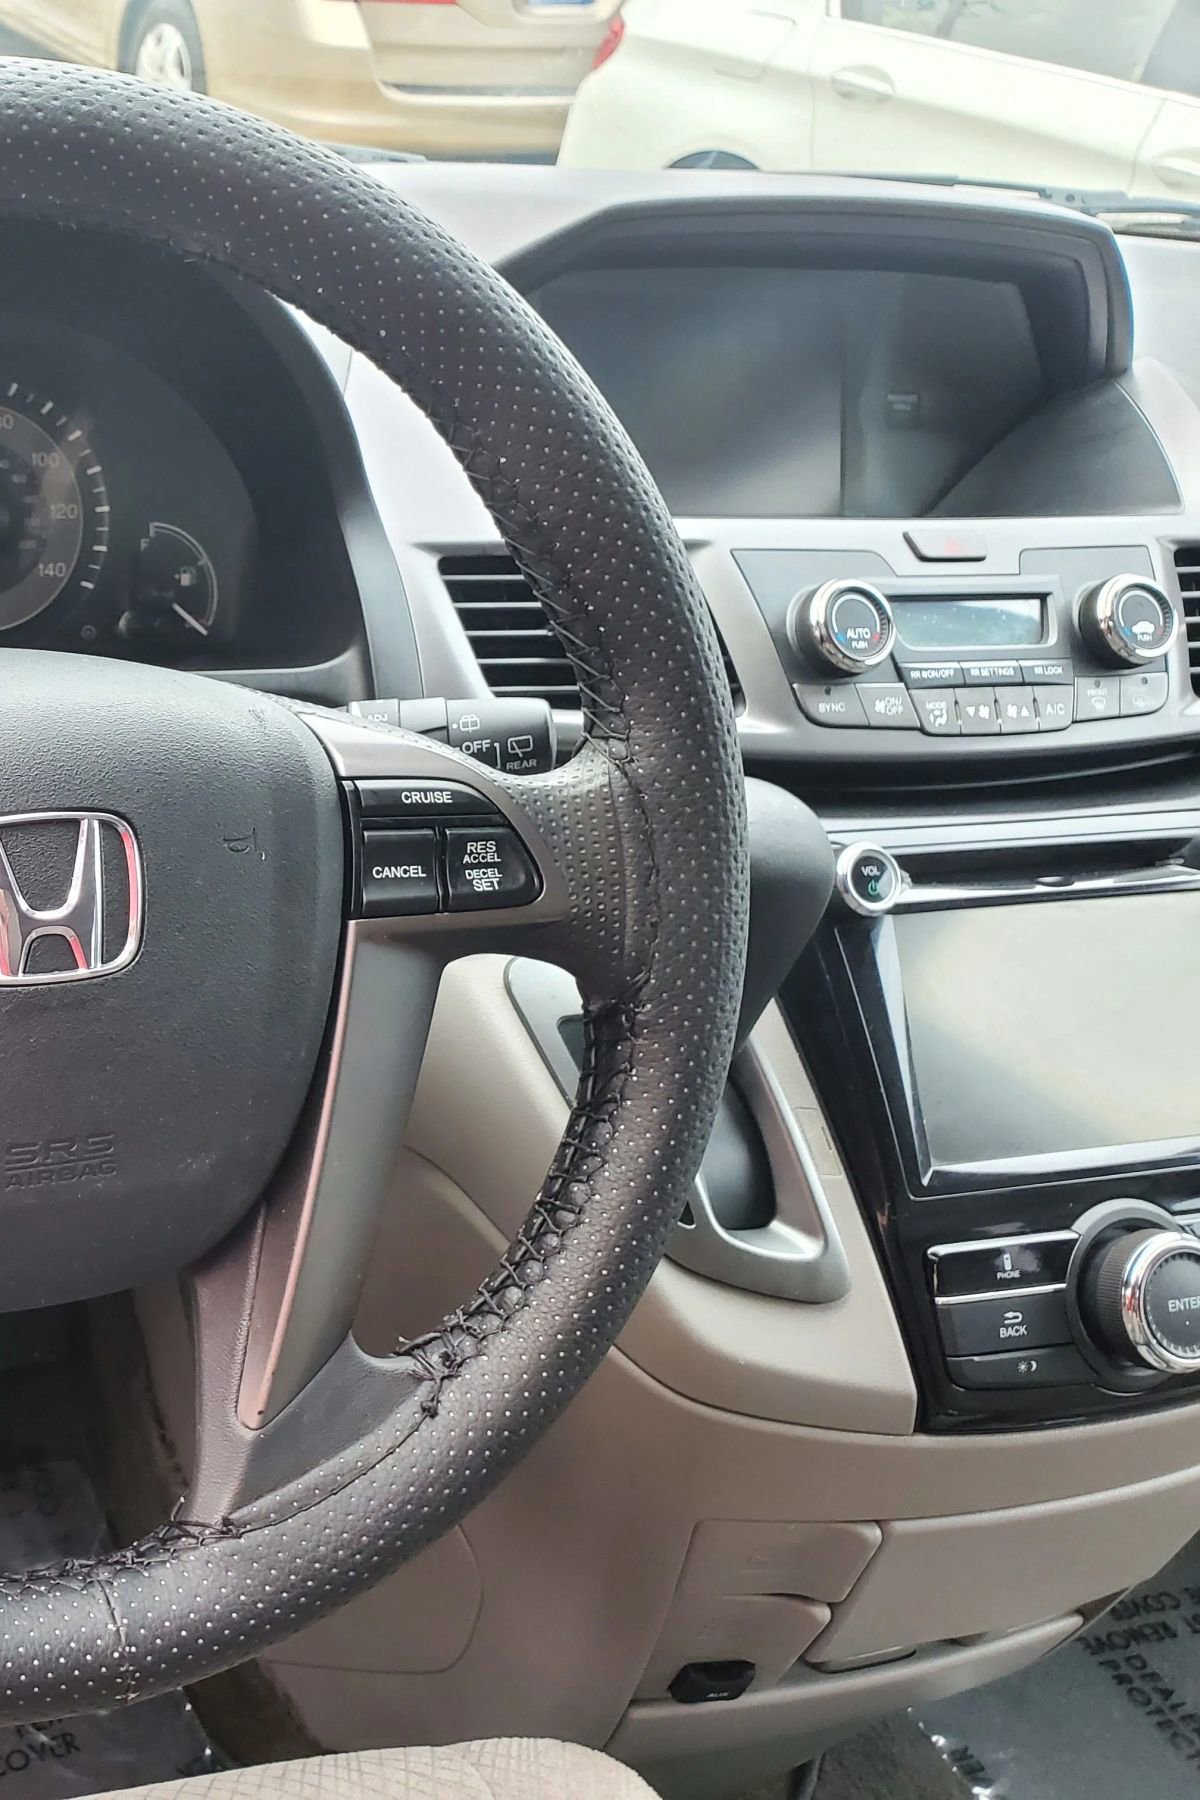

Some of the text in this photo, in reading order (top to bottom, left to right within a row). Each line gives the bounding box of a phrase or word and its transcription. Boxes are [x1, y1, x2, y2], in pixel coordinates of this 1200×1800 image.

[31, 453, 60, 468] 100
[50, 504, 78, 519] 120
[38, 562, 66, 577] 140
[847, 628, 870, 639] AUTO
[818, 703, 846, 713] SYNC
[1046, 703, 1065, 715] A/C
[461, 739, 491, 755] OFF
[506, 759, 538, 771] REAR
[401, 791, 453, 804] CRUISE
[466, 841, 497, 854] RES
[462, 853, 502, 864] ACCEL
[372, 865, 427, 878] CANCEL
[465, 868, 502, 880] DECEL
[861, 865, 880, 877] VOL
[472, 878, 501, 892] SET
[5, 1135, 116, 1169] SRS
[997, 1269, 1022, 1279] PHONE
[1000, 1325, 1028, 1338] BACK
